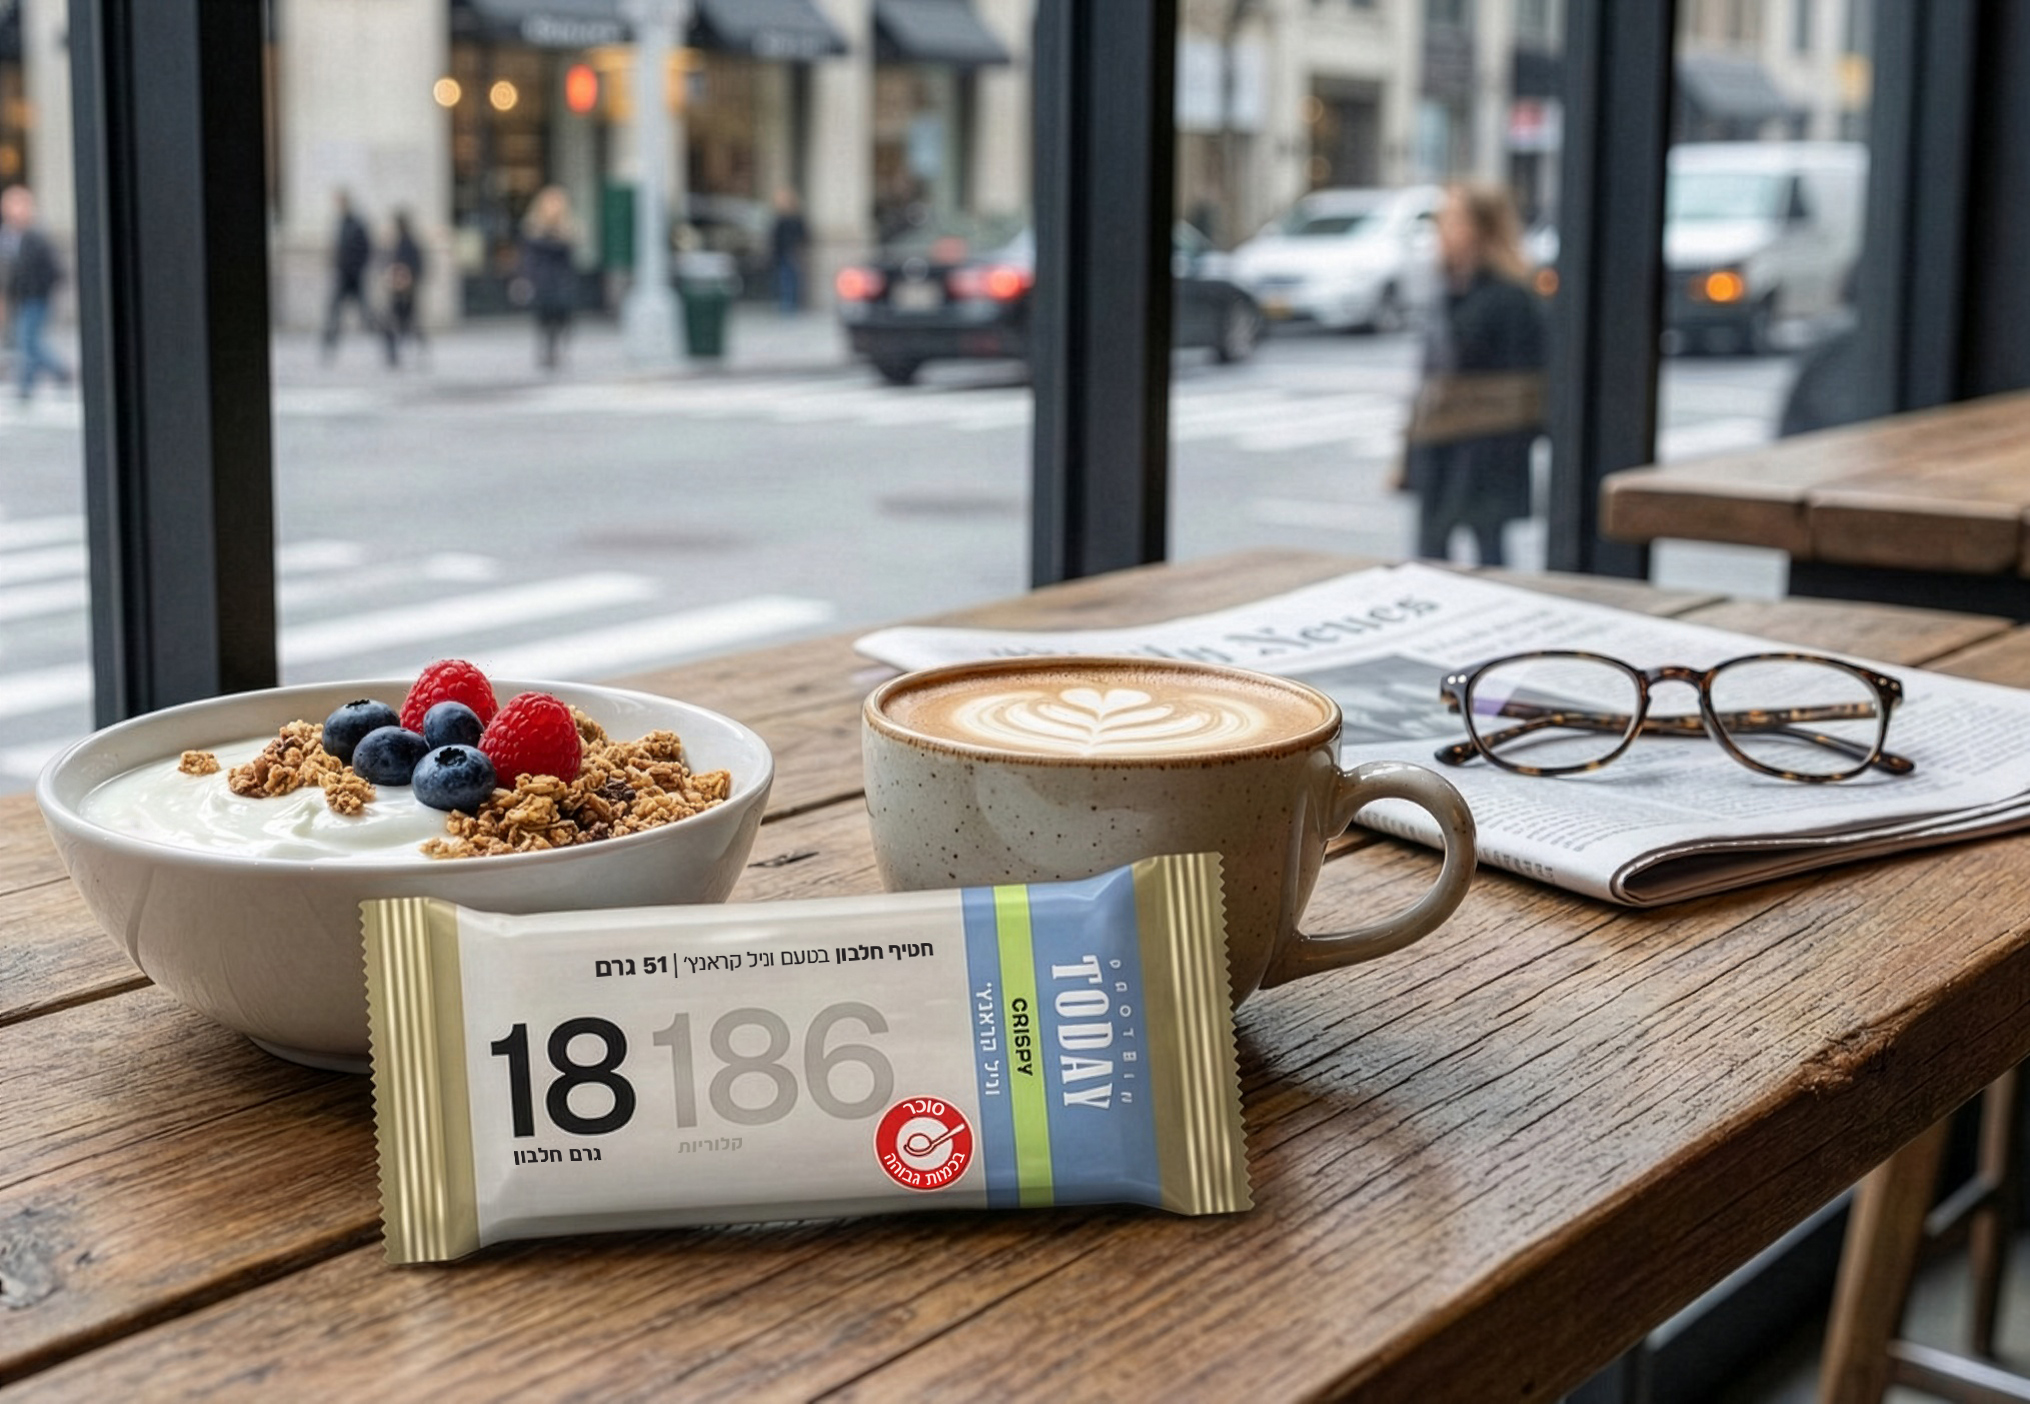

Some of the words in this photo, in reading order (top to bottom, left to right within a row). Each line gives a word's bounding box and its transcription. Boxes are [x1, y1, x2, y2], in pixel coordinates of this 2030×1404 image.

[747, 951, 774, 968] וניל
[781, 948, 830, 966] בטעם
[835, 944, 884, 964] חלבון
[888, 942, 934, 960] חטיף
[595, 958, 636, 977] גרם
[643, 956, 667, 974] 51
[1011, 997, 1033, 1076] CRISPY
[1052, 955, 1113, 1109] TODAY
[652, 1001, 894, 1129] 186
[490, 1016, 636, 1138] 18
[984, 1060, 1000, 1095] וניל
[902, 1100, 945, 1116] סוכר
[569, 1147, 602, 1162] גרם
[678, 1137, 743, 1153] קלוריות
[513, 1147, 562, 1165] חלבון
[884, 1153, 920, 1185] גבוהה
[925, 1152, 965, 1185] בכמות
